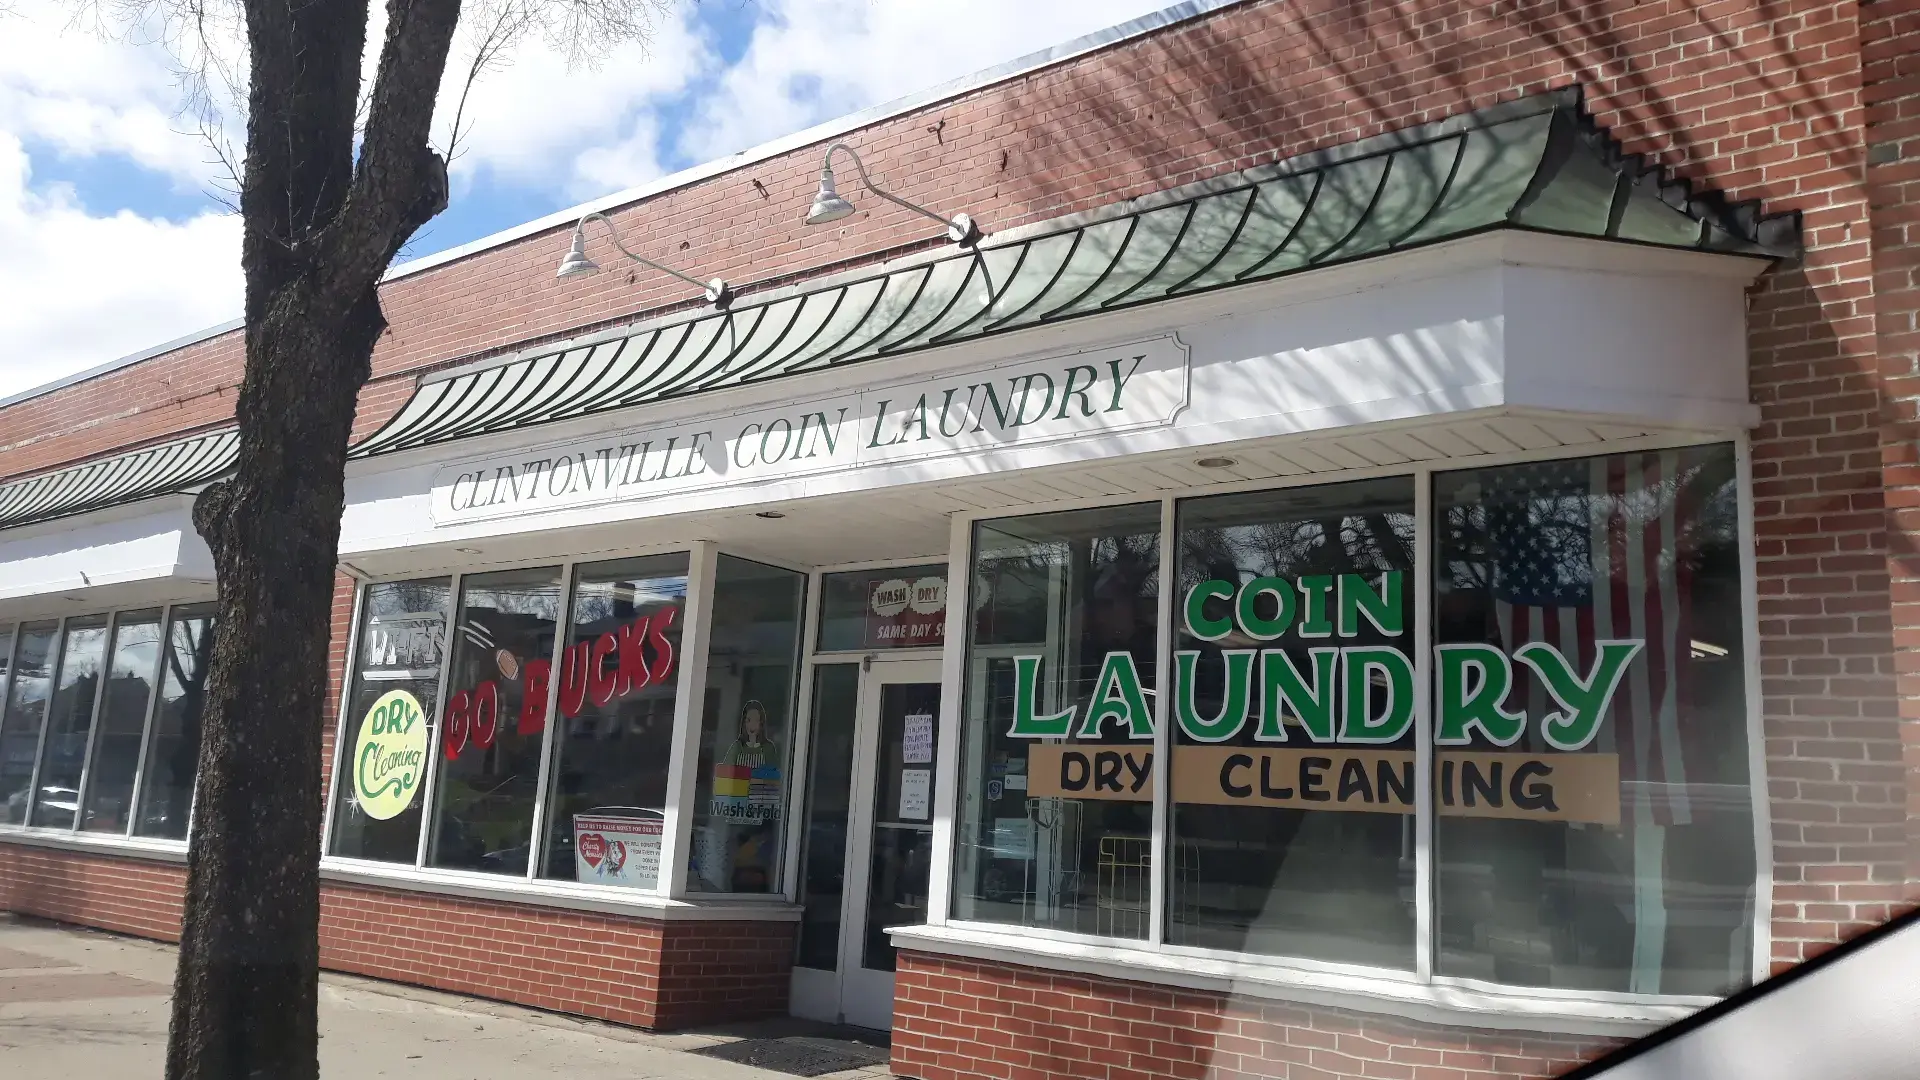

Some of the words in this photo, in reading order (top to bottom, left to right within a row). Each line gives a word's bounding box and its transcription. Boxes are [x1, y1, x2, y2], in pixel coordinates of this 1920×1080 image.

[451, 431, 712, 511] CLINTONVILLE
[734, 407, 848, 468] COIN
[866, 354, 1147, 448] LAUNDRY
[877, 588, 906, 605] WASH
[917, 587, 939, 601] DRY
[1184, 570, 1403, 641] COIN
[877, 624, 908, 639] SAME
[910, 623, 931, 637] DAY
[443, 679, 498, 760] GO
[517, 606, 678, 735] BUCKS
[1006, 638, 1646, 751] LAUNDRY
[371, 698, 419, 735] DRY
[359, 741, 422, 798] Cleaning
[1060, 751, 1154, 794] DRY
[1219, 753, 1560, 813] CLEANING
